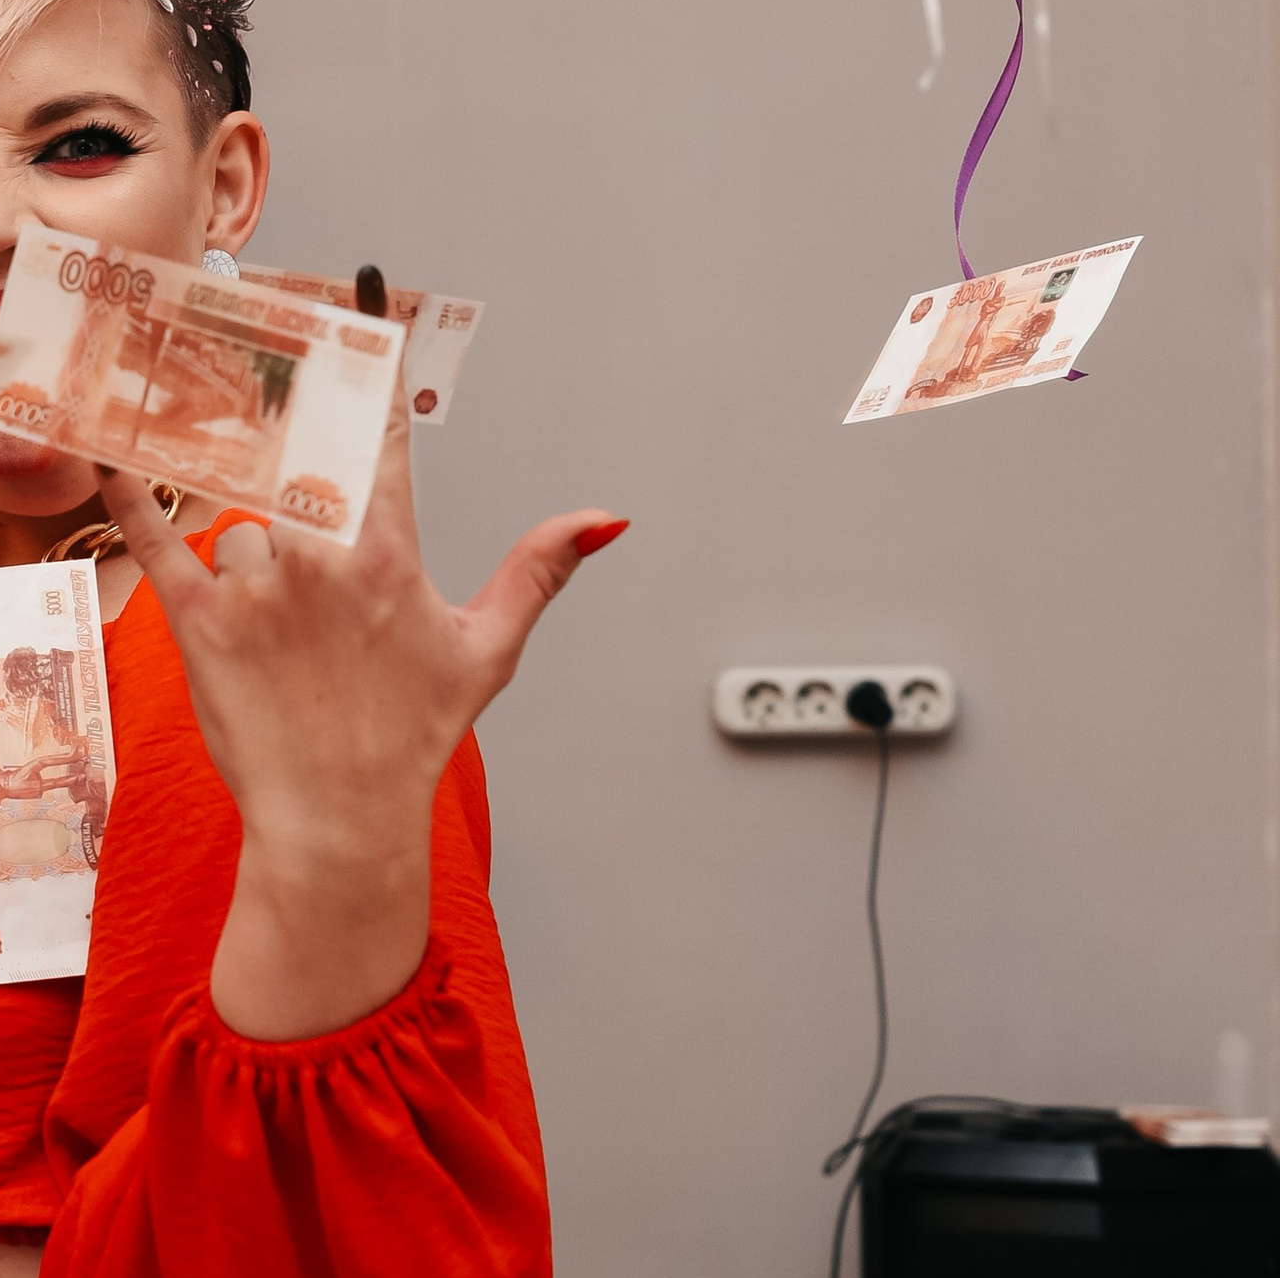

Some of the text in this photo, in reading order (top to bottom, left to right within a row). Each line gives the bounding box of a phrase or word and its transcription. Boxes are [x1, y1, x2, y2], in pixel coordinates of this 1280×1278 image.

[60, 250, 156, 310] 5000
[947, 277, 997, 309] 5000
[45, 590, 63, 616] 5000
[69, 568, 108, 770] ПЯТЬ ТЫСЯЧ ДУБЛЕЙ
[82, 821, 98, 864] МОСКВА
